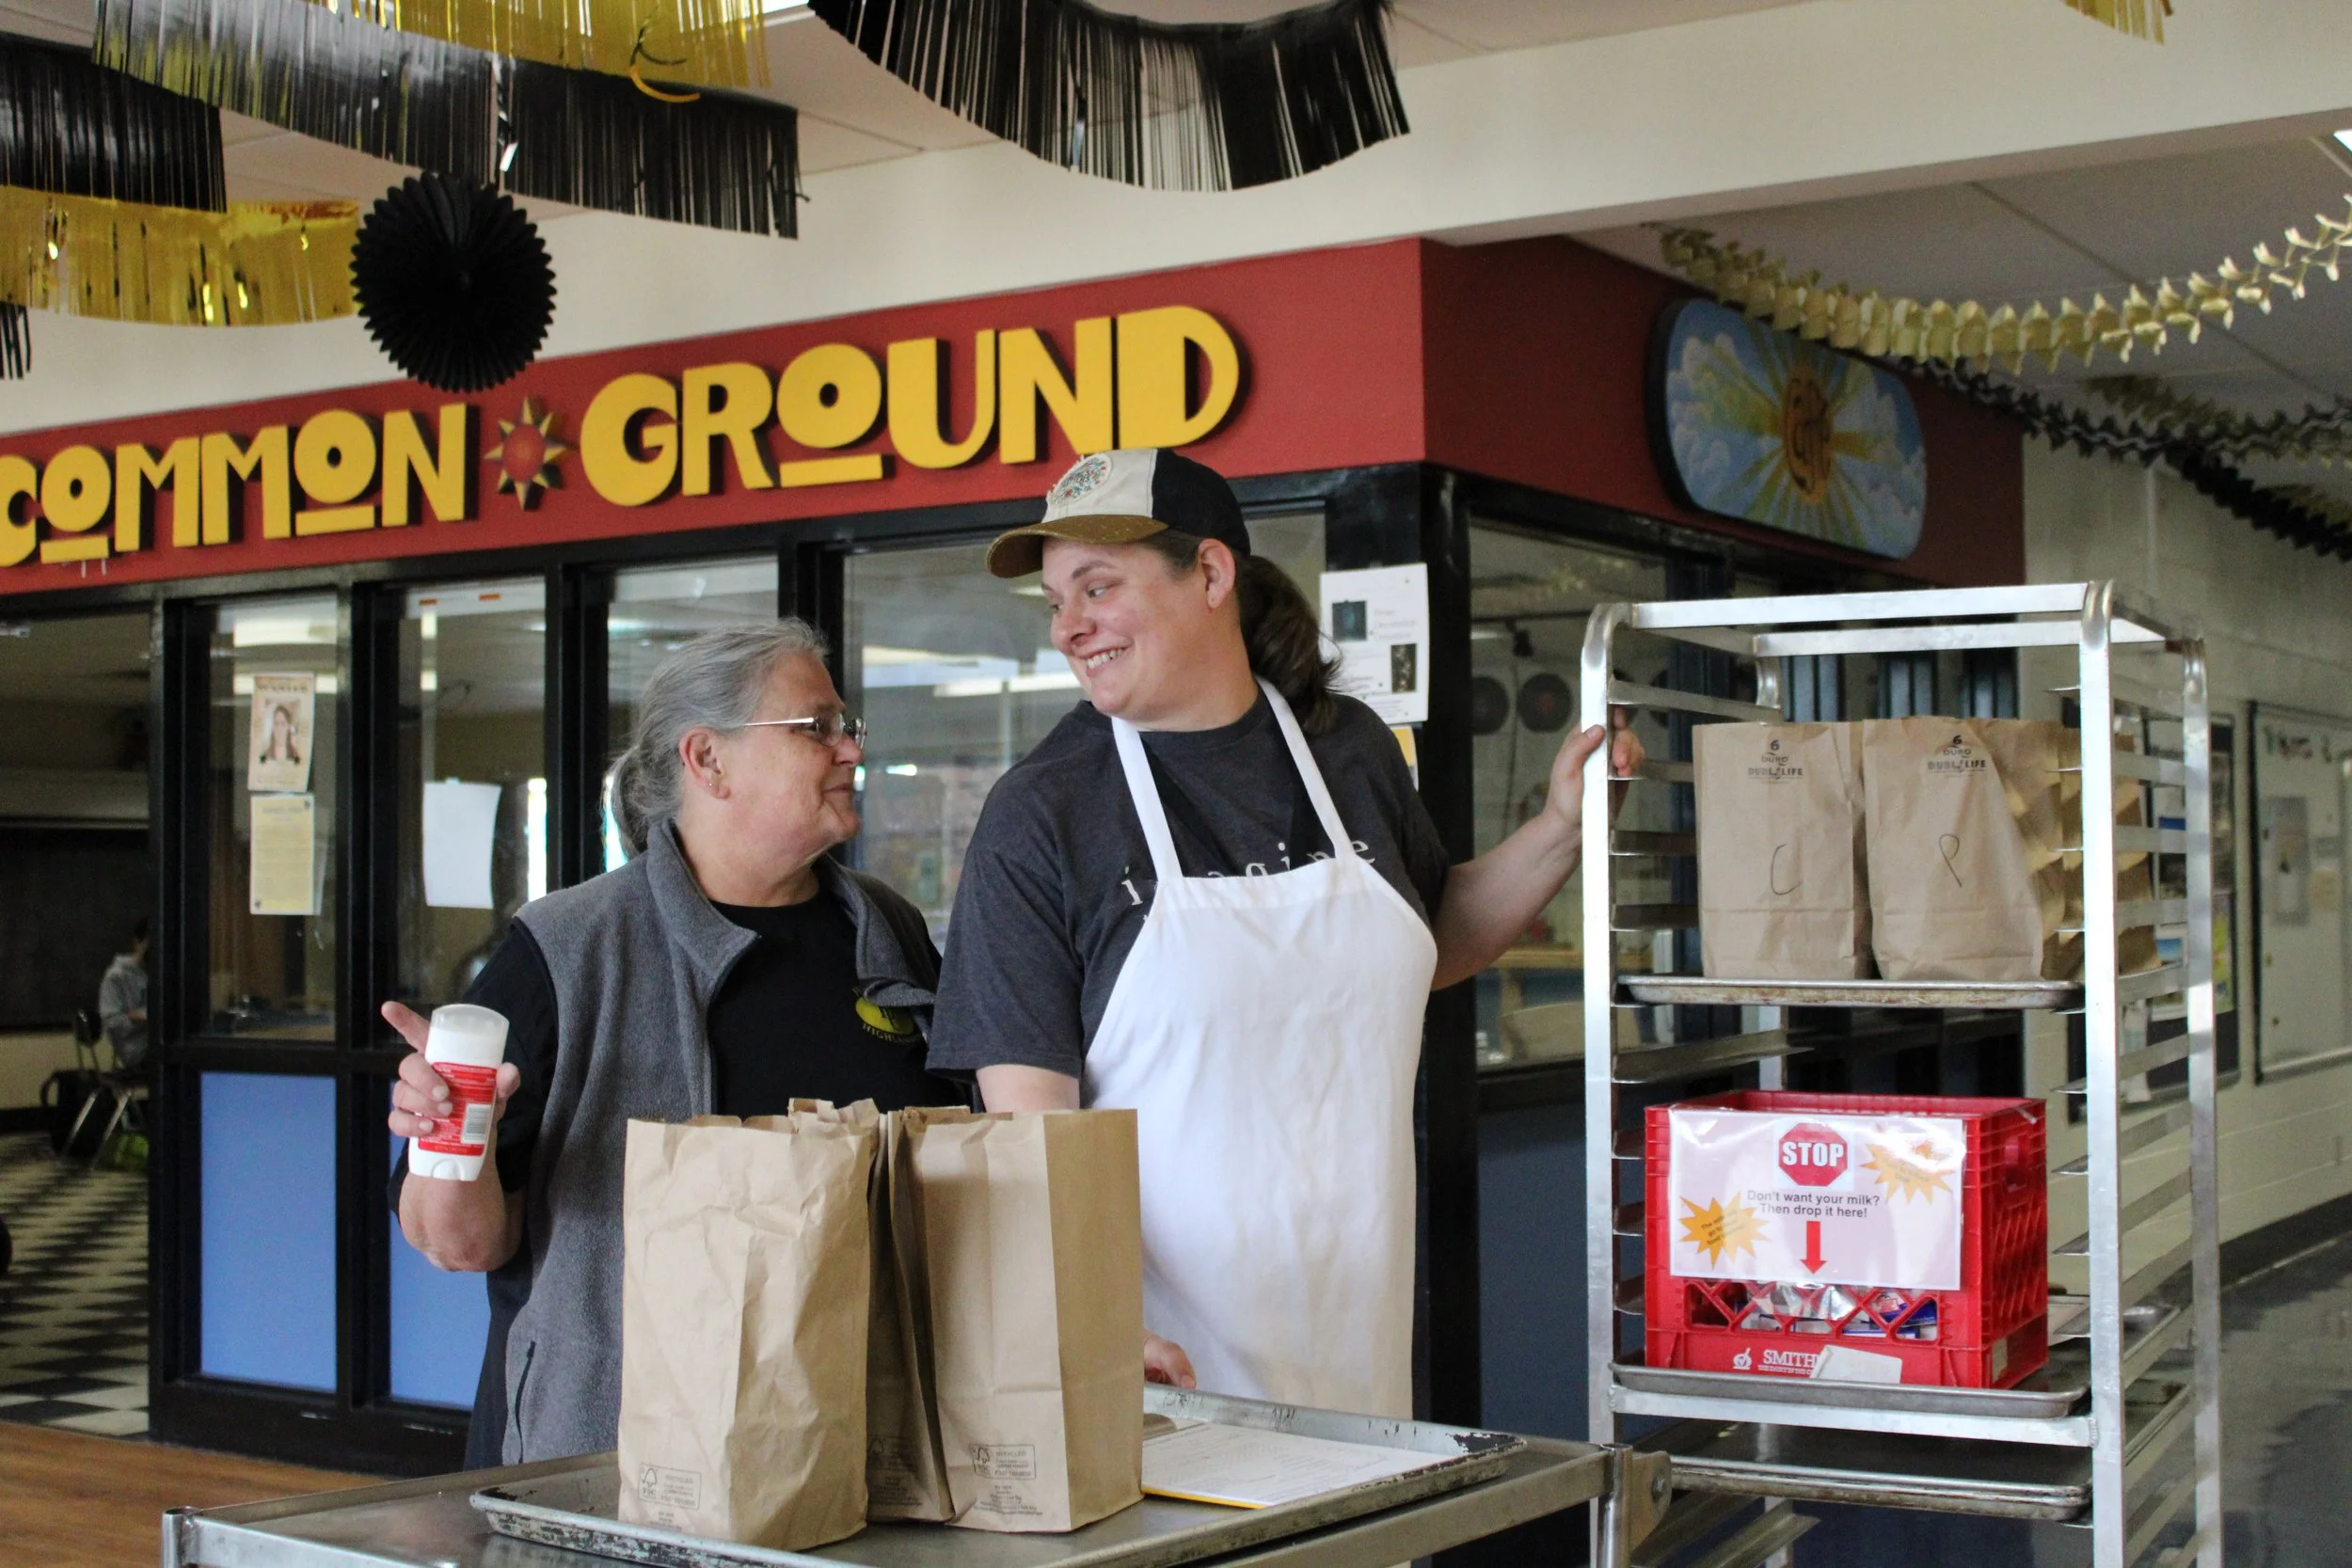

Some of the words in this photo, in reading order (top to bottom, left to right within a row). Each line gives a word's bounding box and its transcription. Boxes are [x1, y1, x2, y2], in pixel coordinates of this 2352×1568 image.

[0, 403, 468, 566] COMMON
[580, 306, 1239, 507] GROUND
[1770, 739, 1780, 752] 6
[1952, 735, 1963, 745] 6
[1964, 759, 1986, 768] LIFE
[1781, 768, 1804, 776] LIFE
[1782, 1141, 1844, 1167] STOP
[1747, 1190, 1780, 1201] Don't
[1784, 1192, 1812, 1203] want
[1816, 1195, 1843, 1205] your
[1847, 1195, 1880, 1206] milk?
[1760, 1203, 1789, 1214] Then
[1794, 1205, 1822, 1217] drop
[1825, 1206, 1833, 1216] it
[1836, 1207, 1867, 1218] here!
[1762, 1349, 1820, 1368] SMITH
